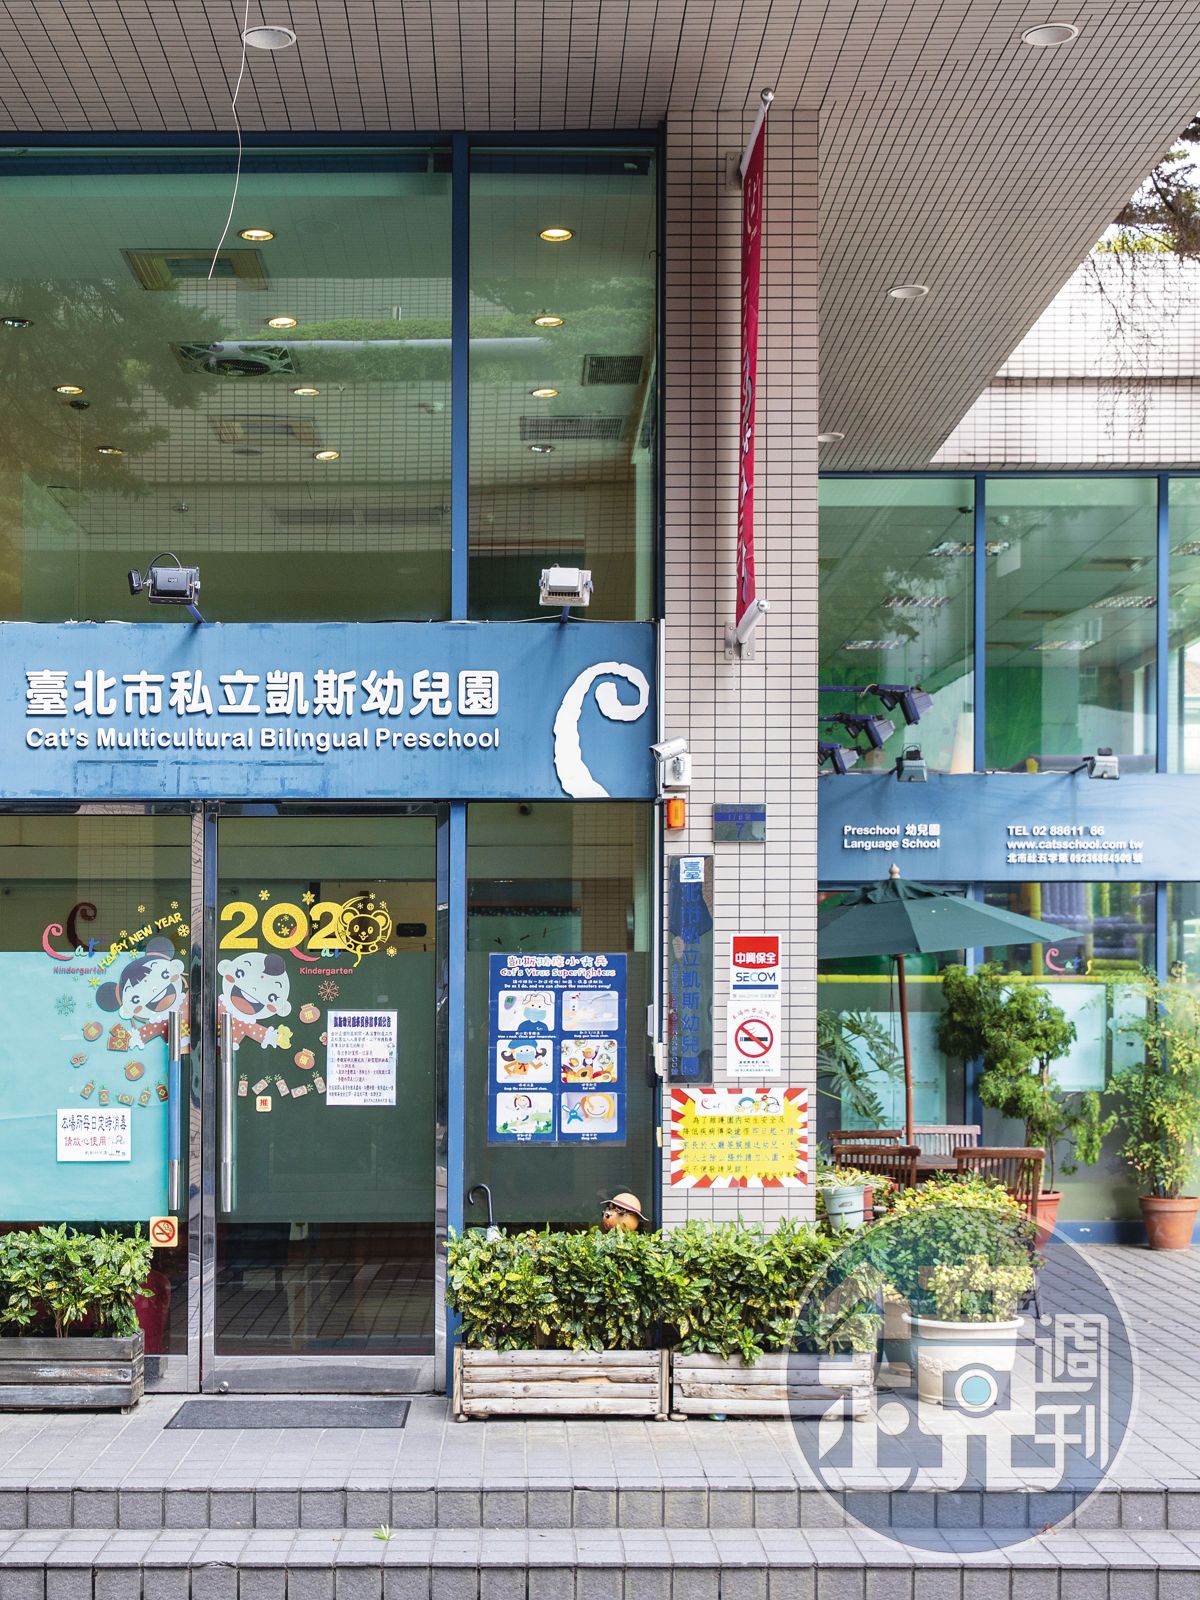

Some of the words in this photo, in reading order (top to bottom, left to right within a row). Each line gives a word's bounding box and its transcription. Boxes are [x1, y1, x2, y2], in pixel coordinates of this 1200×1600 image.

[25, 669, 501, 717] 臺北市私立凱斯幼兒園
[25, 727, 89, 749] Cat's
[96, 727, 254, 749] Multicultural
[260, 727, 369, 753] Bilingual
[375, 727, 500, 749] Preschool
[843, 825, 900, 836] Preschool
[1007, 826, 1030, 836] TEL
[1032, 826, 1047, 836] 02
[843, 838, 899, 850] Language
[901, 838, 941, 849] School
[128, 925, 153, 946] NEW
[154, 912, 183, 930] YEAR
[735, 952, 776, 965] 中興保全
[299, 967, 354, 977] Kindergarten
[736, 972, 776, 982] SECOM
